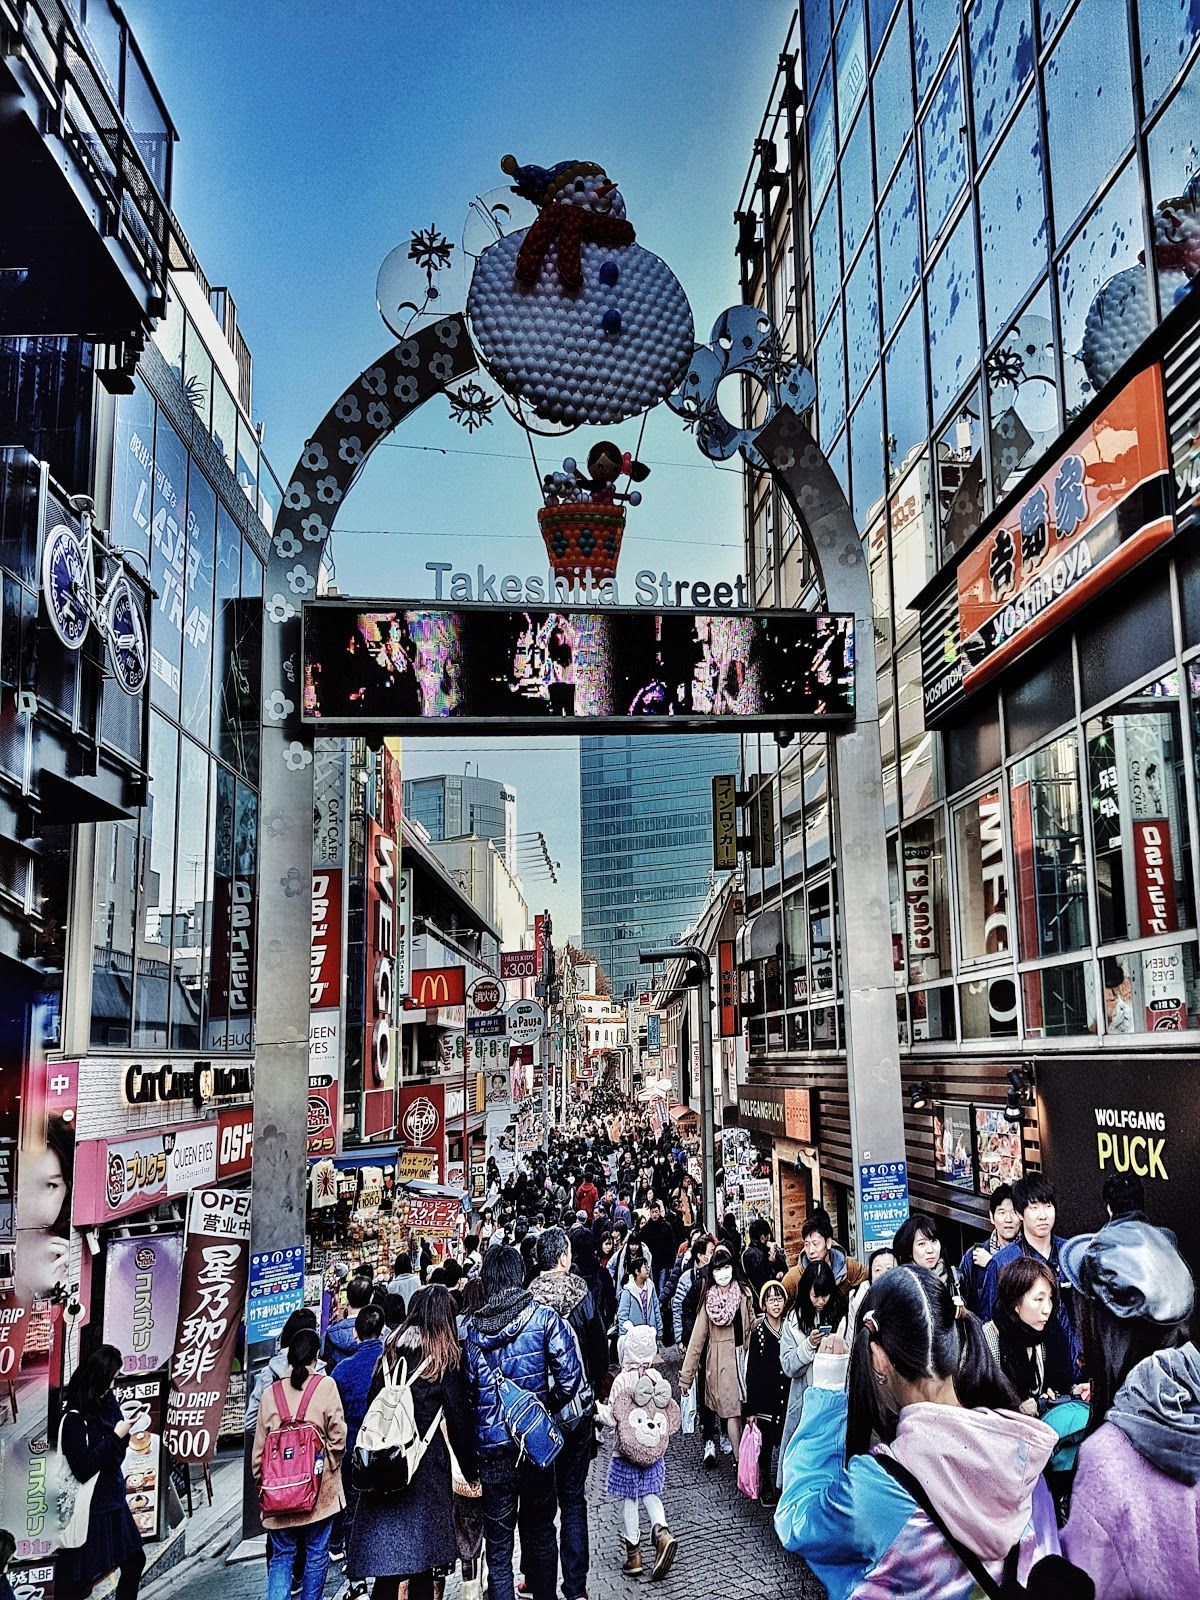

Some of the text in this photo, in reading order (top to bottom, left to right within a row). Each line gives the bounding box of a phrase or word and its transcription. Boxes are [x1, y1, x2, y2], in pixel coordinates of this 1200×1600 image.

[132, 479, 200, 591] LASER
[988, 454, 1088, 603] 吉野家
[425, 562, 746, 608] Takeshita Street
[993, 540, 1092, 645] YOSHINOYA
[115, 600, 131, 622] Bike
[159, 568, 211, 649] TRAP
[718, 777, 735, 858] コインロッカー
[327, 799, 338, 859] CAT CAFE
[374, 834, 398, 1081] WEGO
[503, 962, 534, 977] ¥300
[474, 989, 498, 1003] 消火栓
[308, 1041, 328, 1054] YES
[50, 1074, 70, 1096] 中
[125, 1064, 157, 1103] CAT
[158, 1064, 194, 1101] CAFE
[740, 1098, 784, 1122] WOLFGANG PUCK
[787, 1107, 808, 1124] EXPRESS
[1094, 1108, 1166, 1132] WOLFGANG
[174, 1142, 213, 1169] QUEEN EYES
[220, 1123, 253, 1166] OSド
[401, 1157, 433, 1167] ハッピーワン
[1097, 1132, 1169, 1180] PUCK
[400, 1169, 432, 1179] HAPPY ONE
[339, 1179, 358, 1194] 東京
[407, 1218, 457, 1226] SQUEEZE
[408, 1208, 457, 1222] スクイーズ
[133, 1272, 154, 1352] コスプリ
[172, 1244, 241, 1387] 星乃珈琲
[250, 1299, 302, 1321] 竹下通り公式マップ
[123, 1354, 158, 1372] B1F
[144, 1384, 158, 1397] BF
[187, 1391, 220, 1408] DRIP
[166, 1408, 205, 1427] COFFEE
[26, 1457, 48, 1538] コスプリ
[17, 1539, 51, 1556] B1F
[38, 1568, 52, 1580] BF
